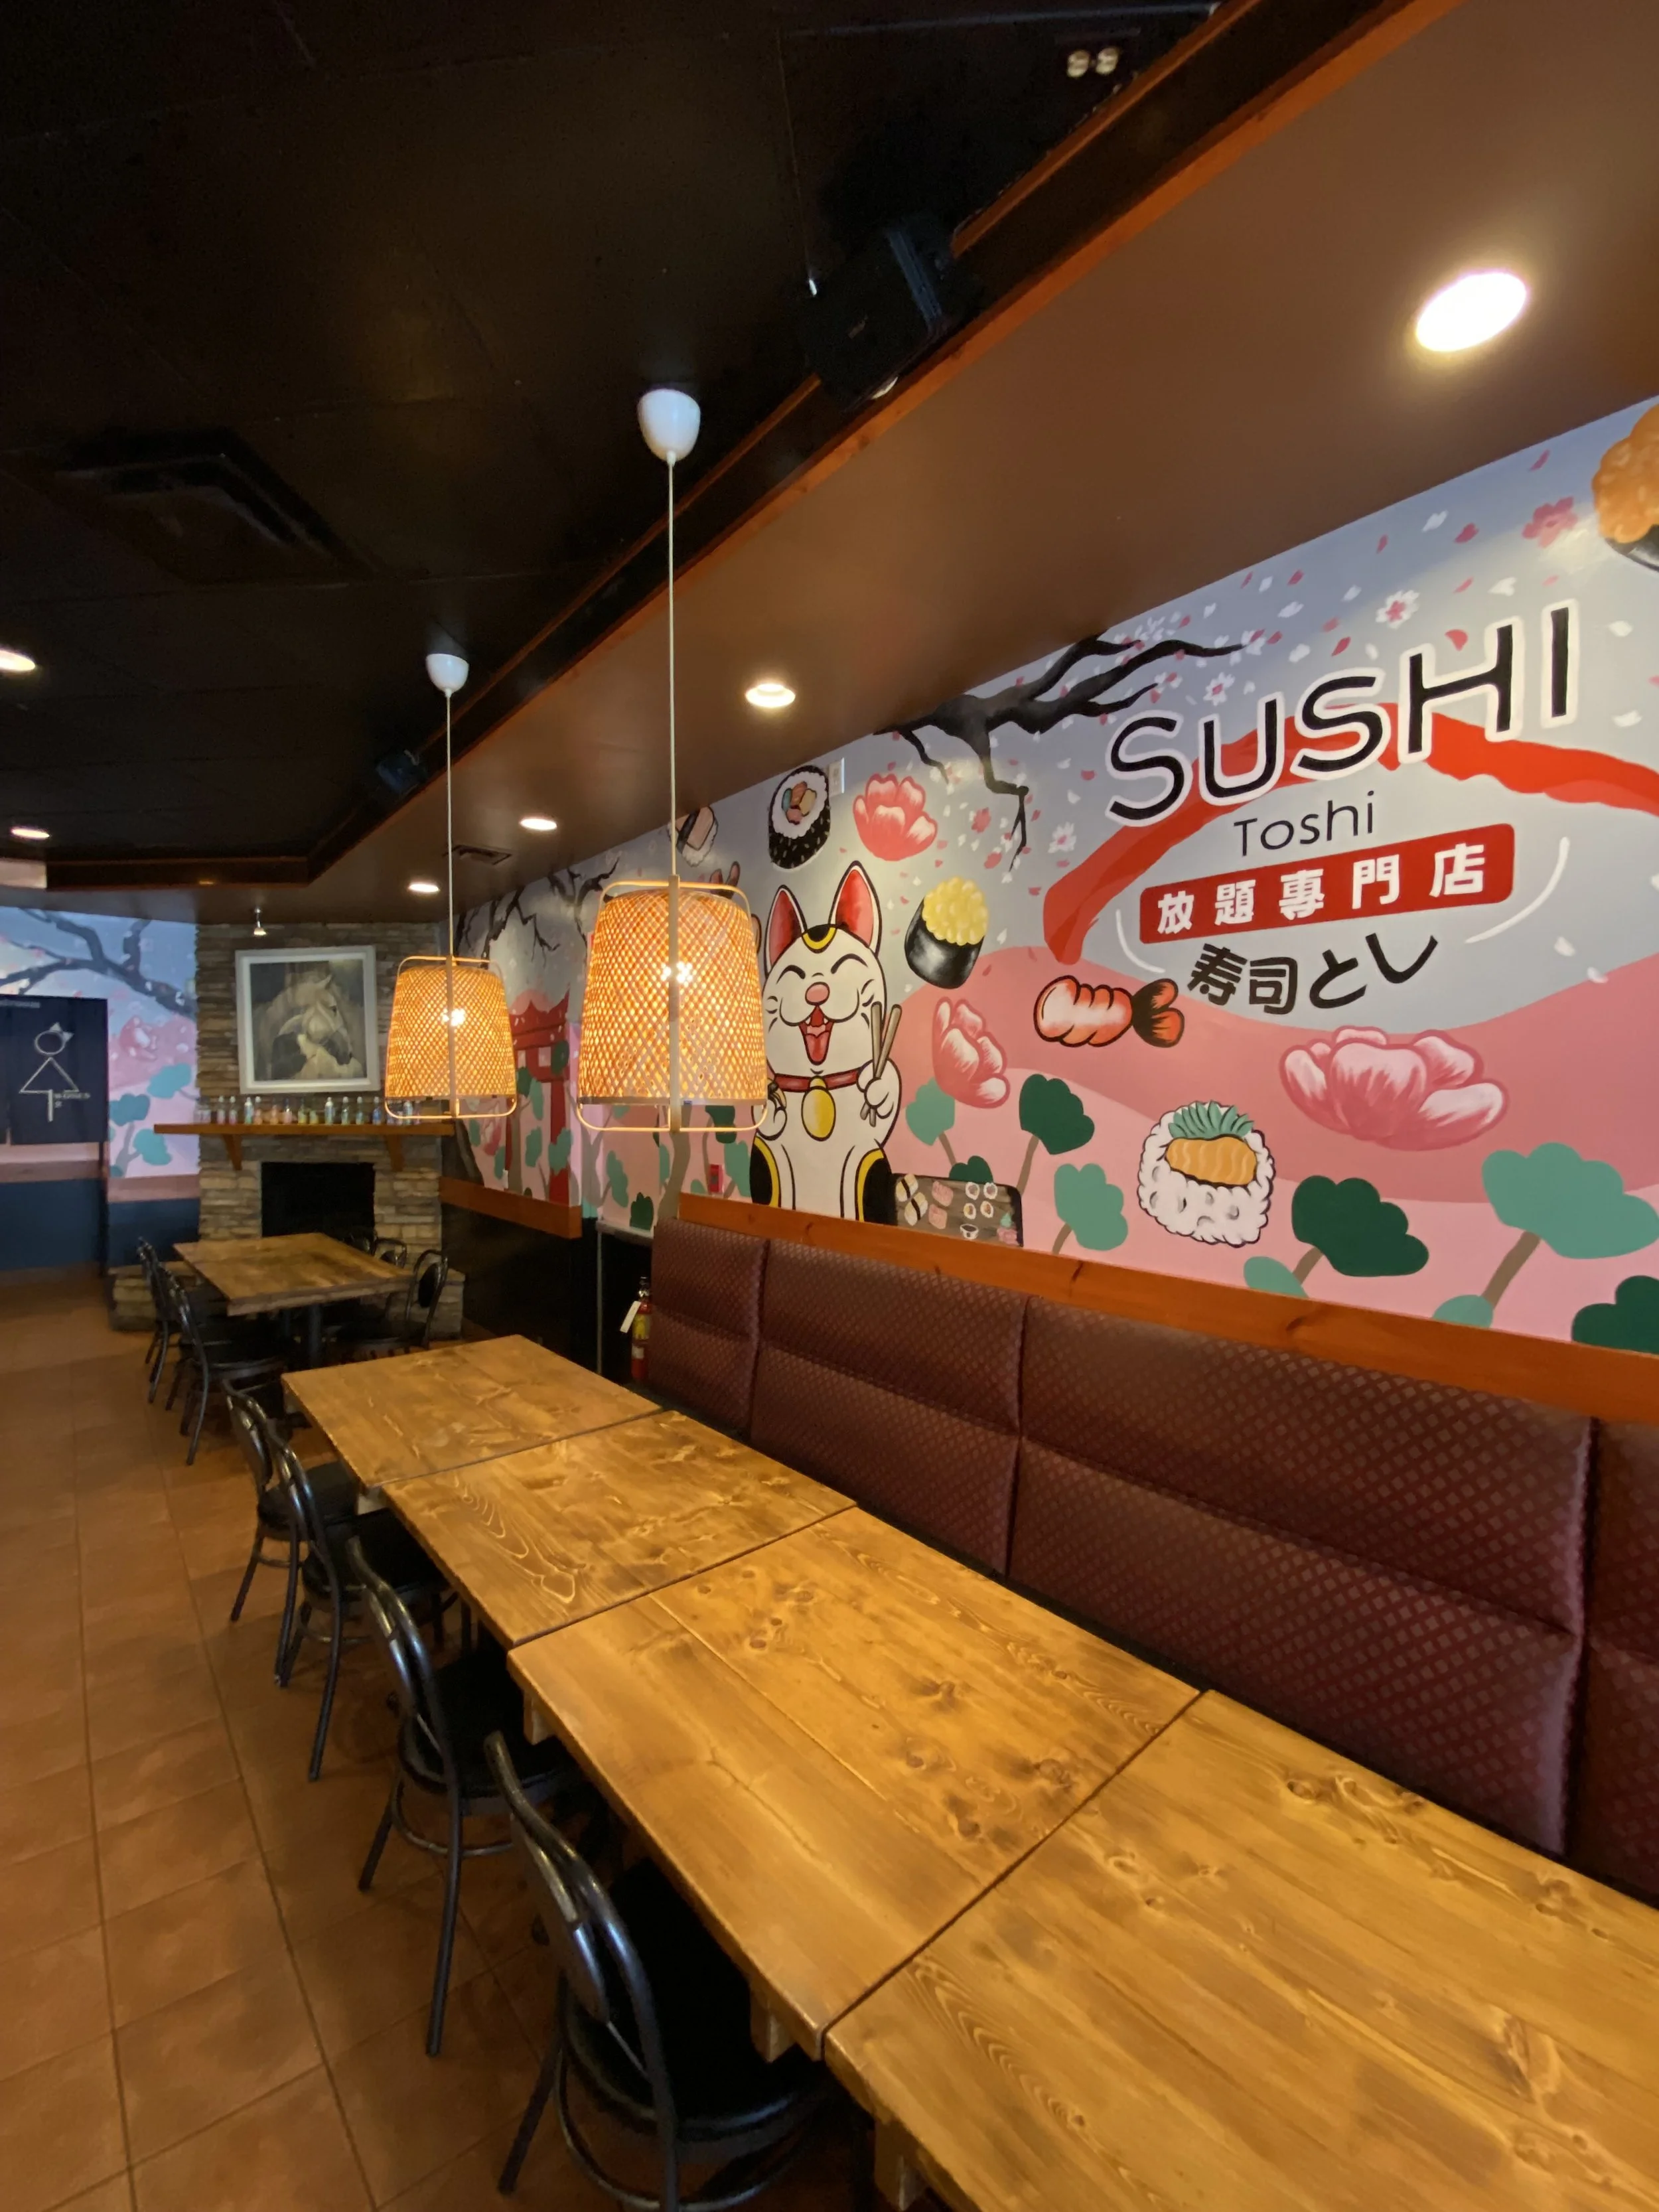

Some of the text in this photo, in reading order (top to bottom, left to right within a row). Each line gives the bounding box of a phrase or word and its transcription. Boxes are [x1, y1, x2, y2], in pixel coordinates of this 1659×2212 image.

[1108, 603, 1571, 822] SUSHI
[1233, 790, 1375, 857] Toshi
[1187, 932, 1439, 1015] 寿司とし
